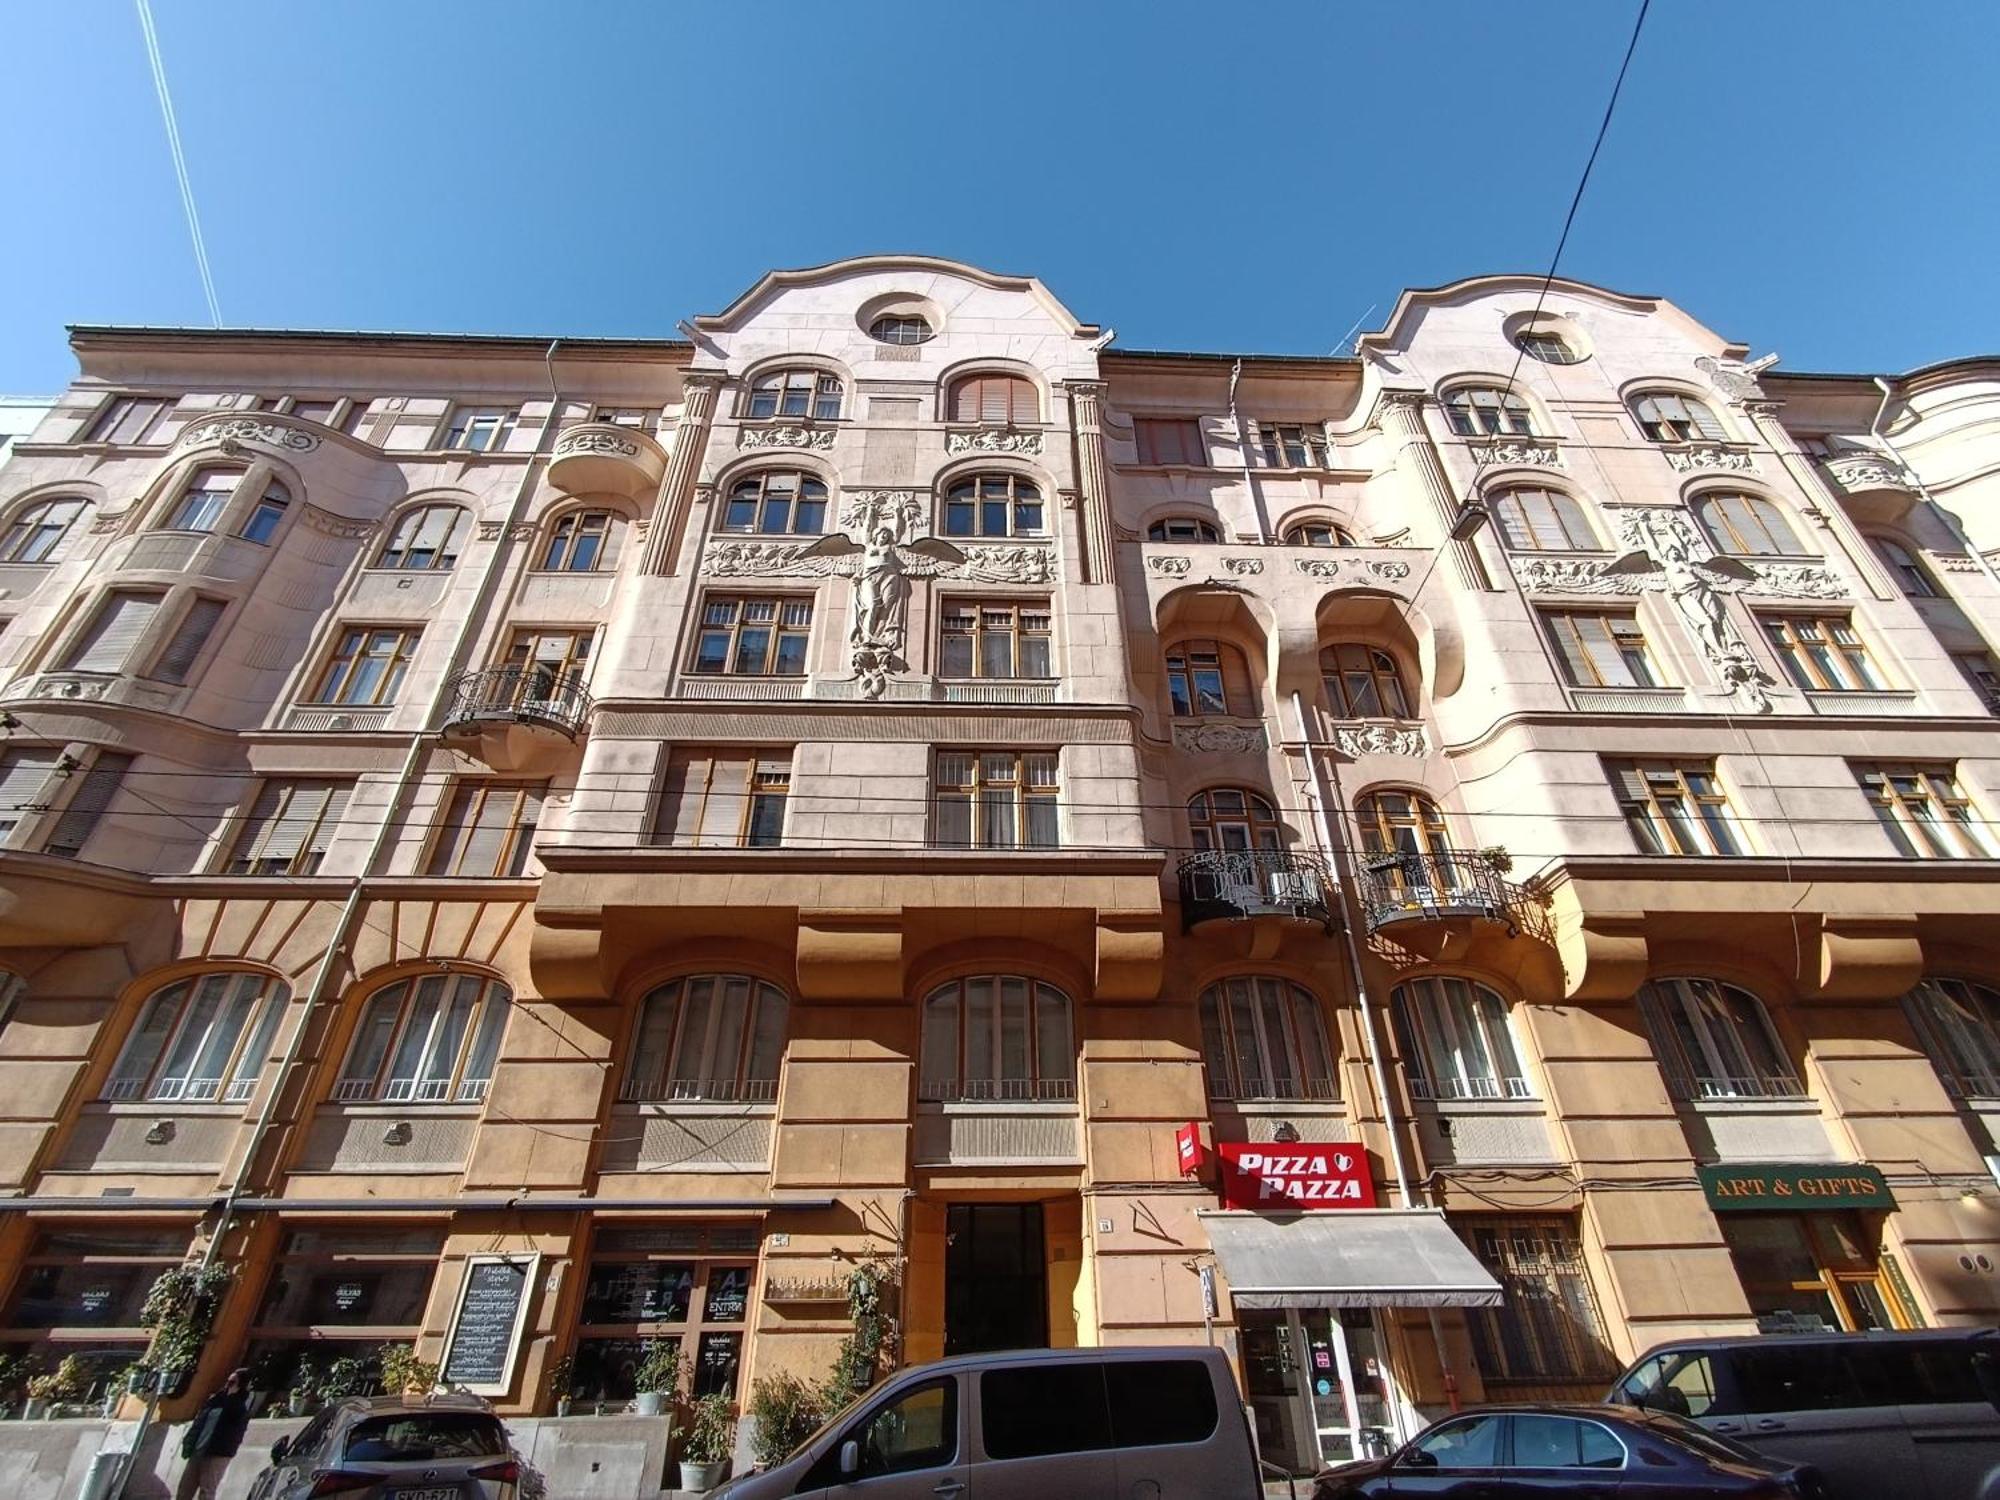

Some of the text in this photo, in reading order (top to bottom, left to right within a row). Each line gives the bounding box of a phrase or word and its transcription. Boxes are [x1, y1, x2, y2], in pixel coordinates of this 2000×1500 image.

[1237, 1154, 1328, 1176] PIZZA
[1259, 1177, 1362, 1200] PAZZA
[1716, 1178, 1877, 1196] ART & GIFTS
